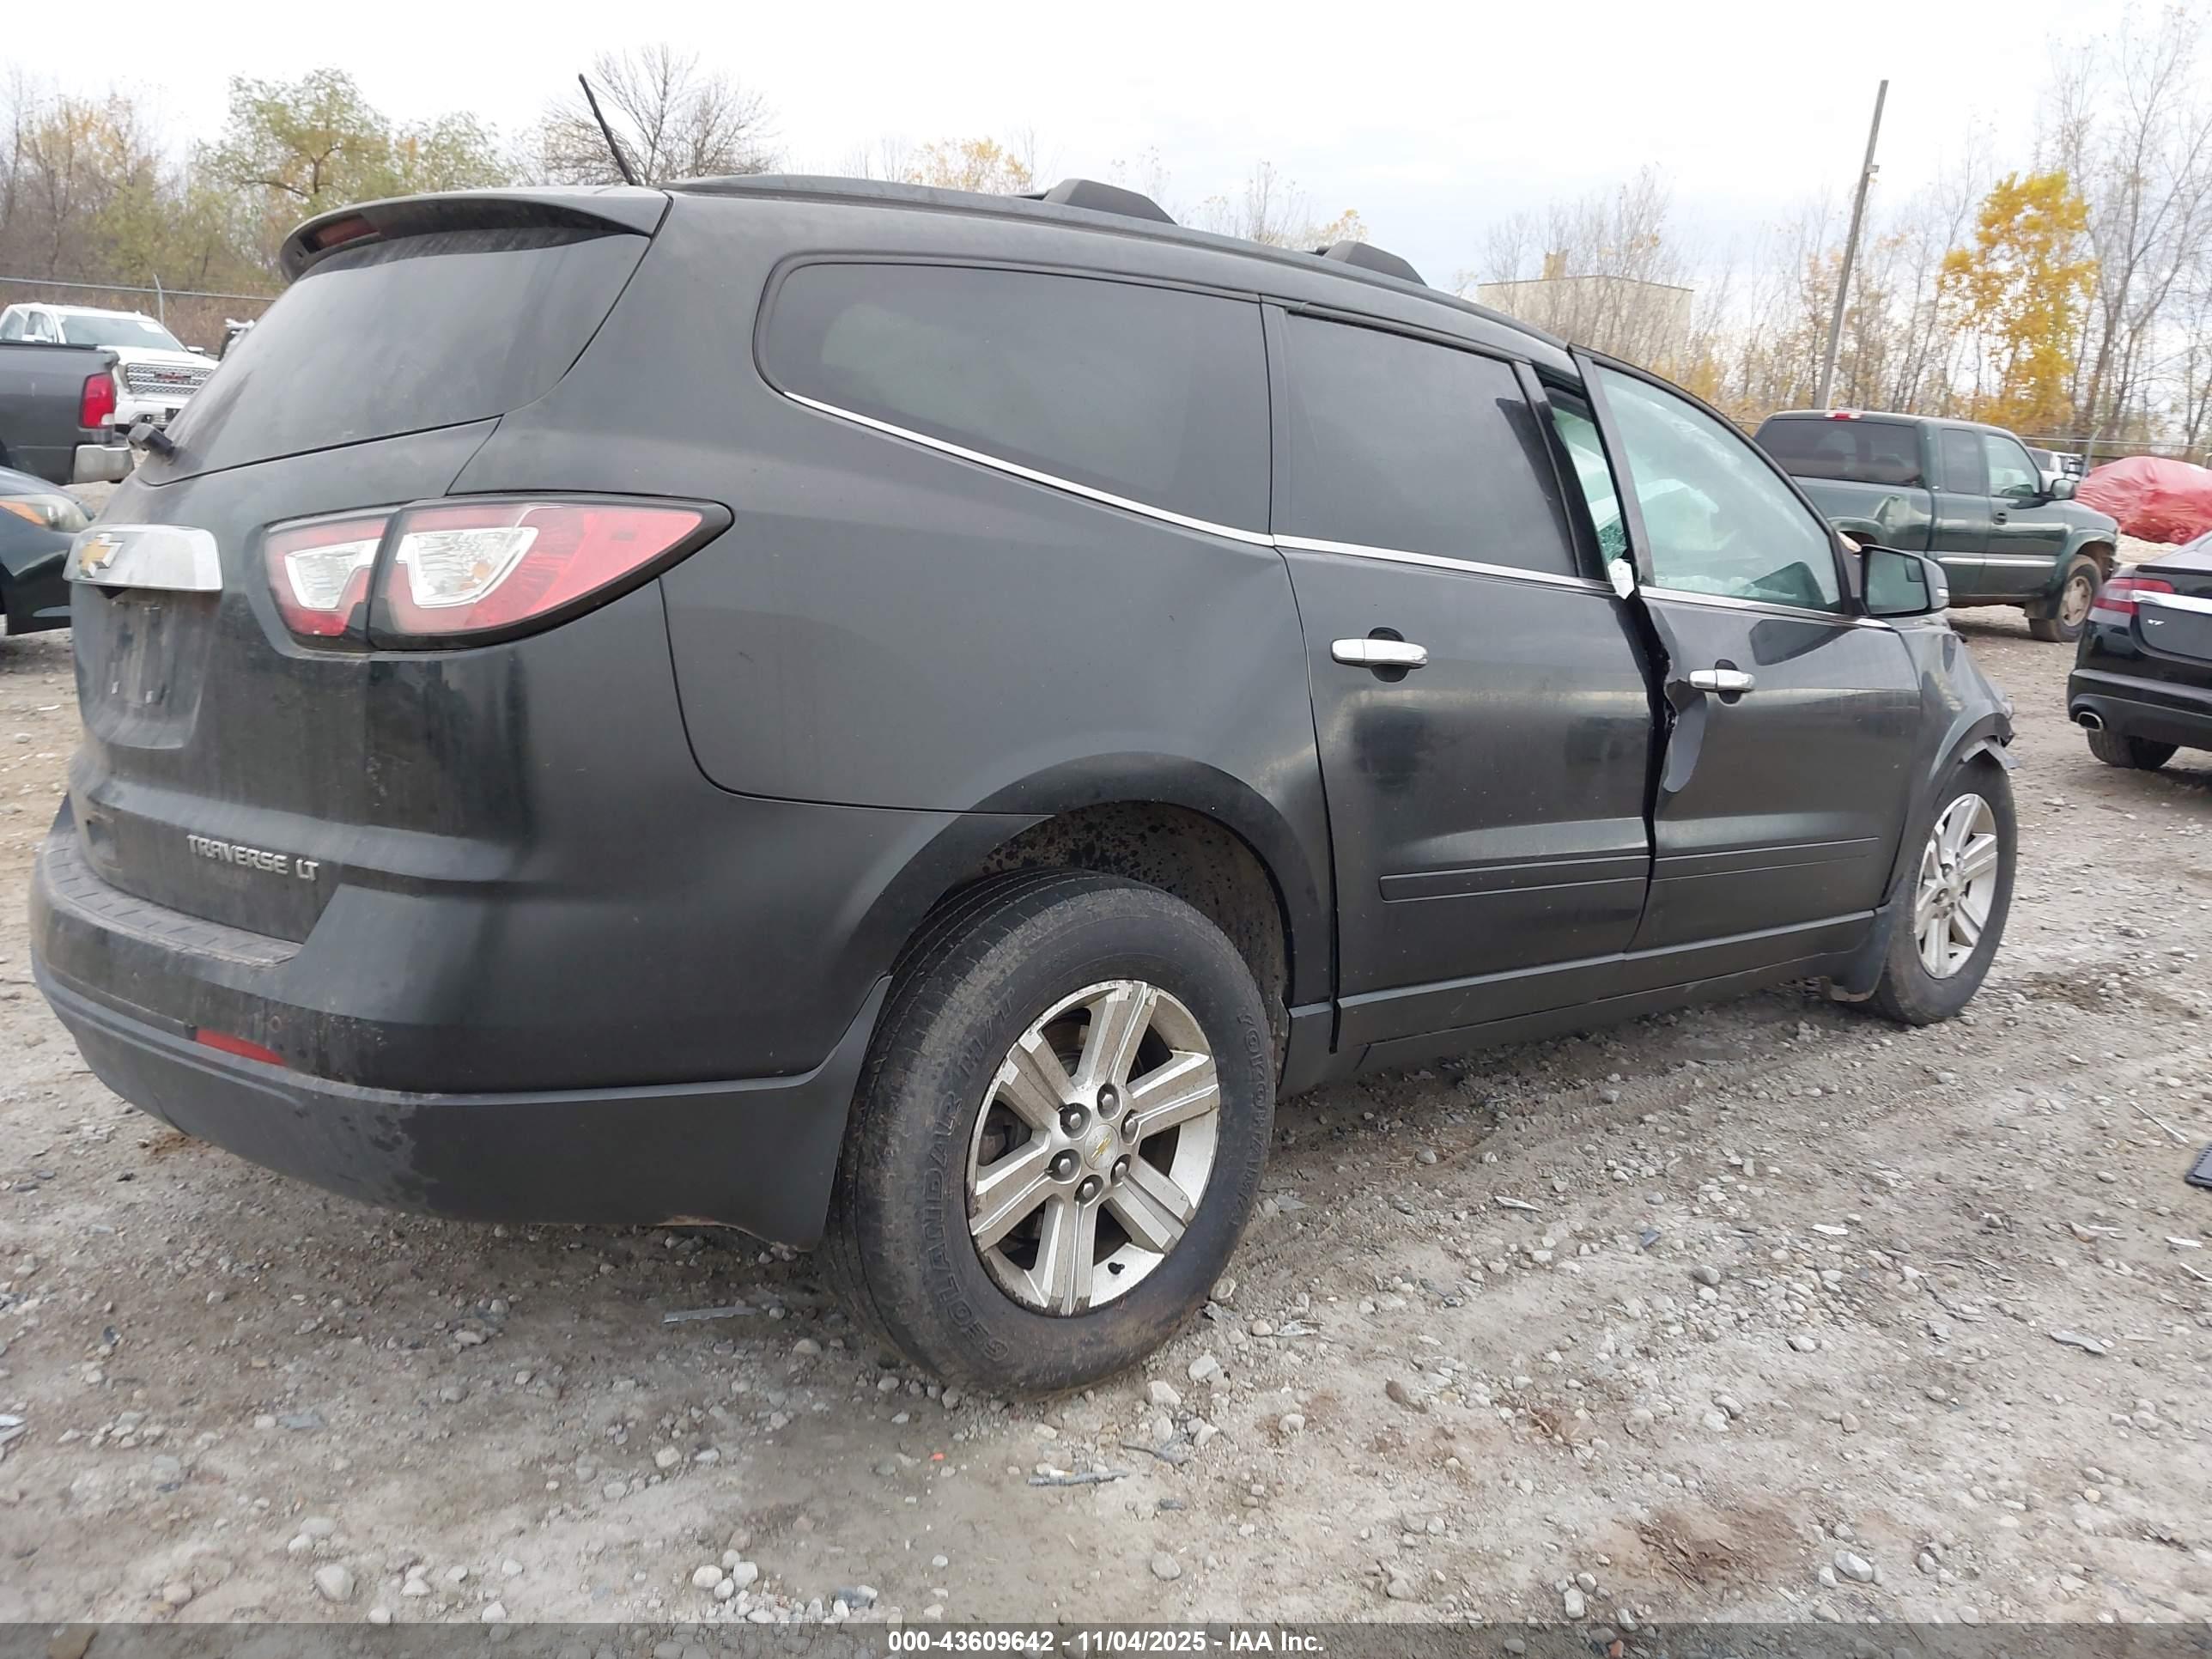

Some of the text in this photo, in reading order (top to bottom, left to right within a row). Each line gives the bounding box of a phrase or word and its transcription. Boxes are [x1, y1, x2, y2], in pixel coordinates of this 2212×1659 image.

[186, 834, 319, 882] TRAVERSE LT
[922, 1091, 1010, 1362] GEOLANDAR
